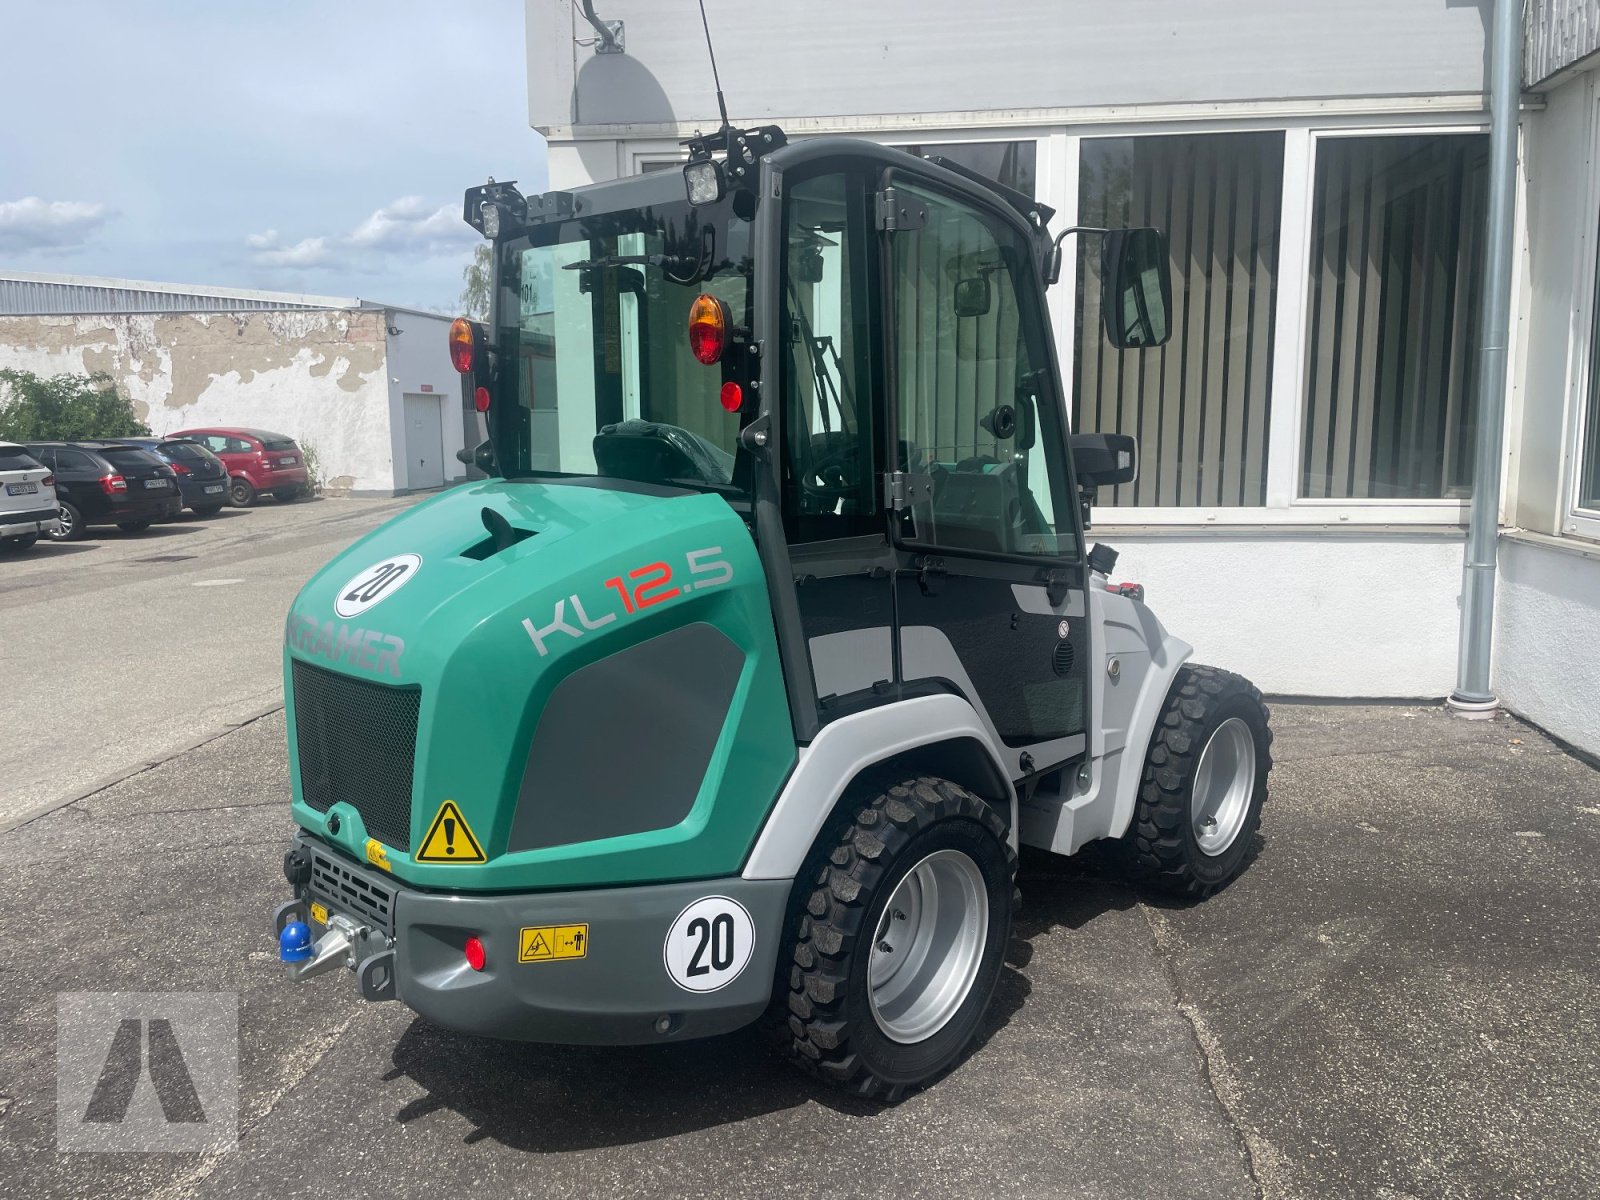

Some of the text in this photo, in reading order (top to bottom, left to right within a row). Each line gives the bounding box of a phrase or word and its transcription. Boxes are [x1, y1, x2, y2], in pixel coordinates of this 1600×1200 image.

[343, 563, 409, 603] 20
[287, 612, 405, 679] KRAMER
[686, 912, 735, 977] 20
